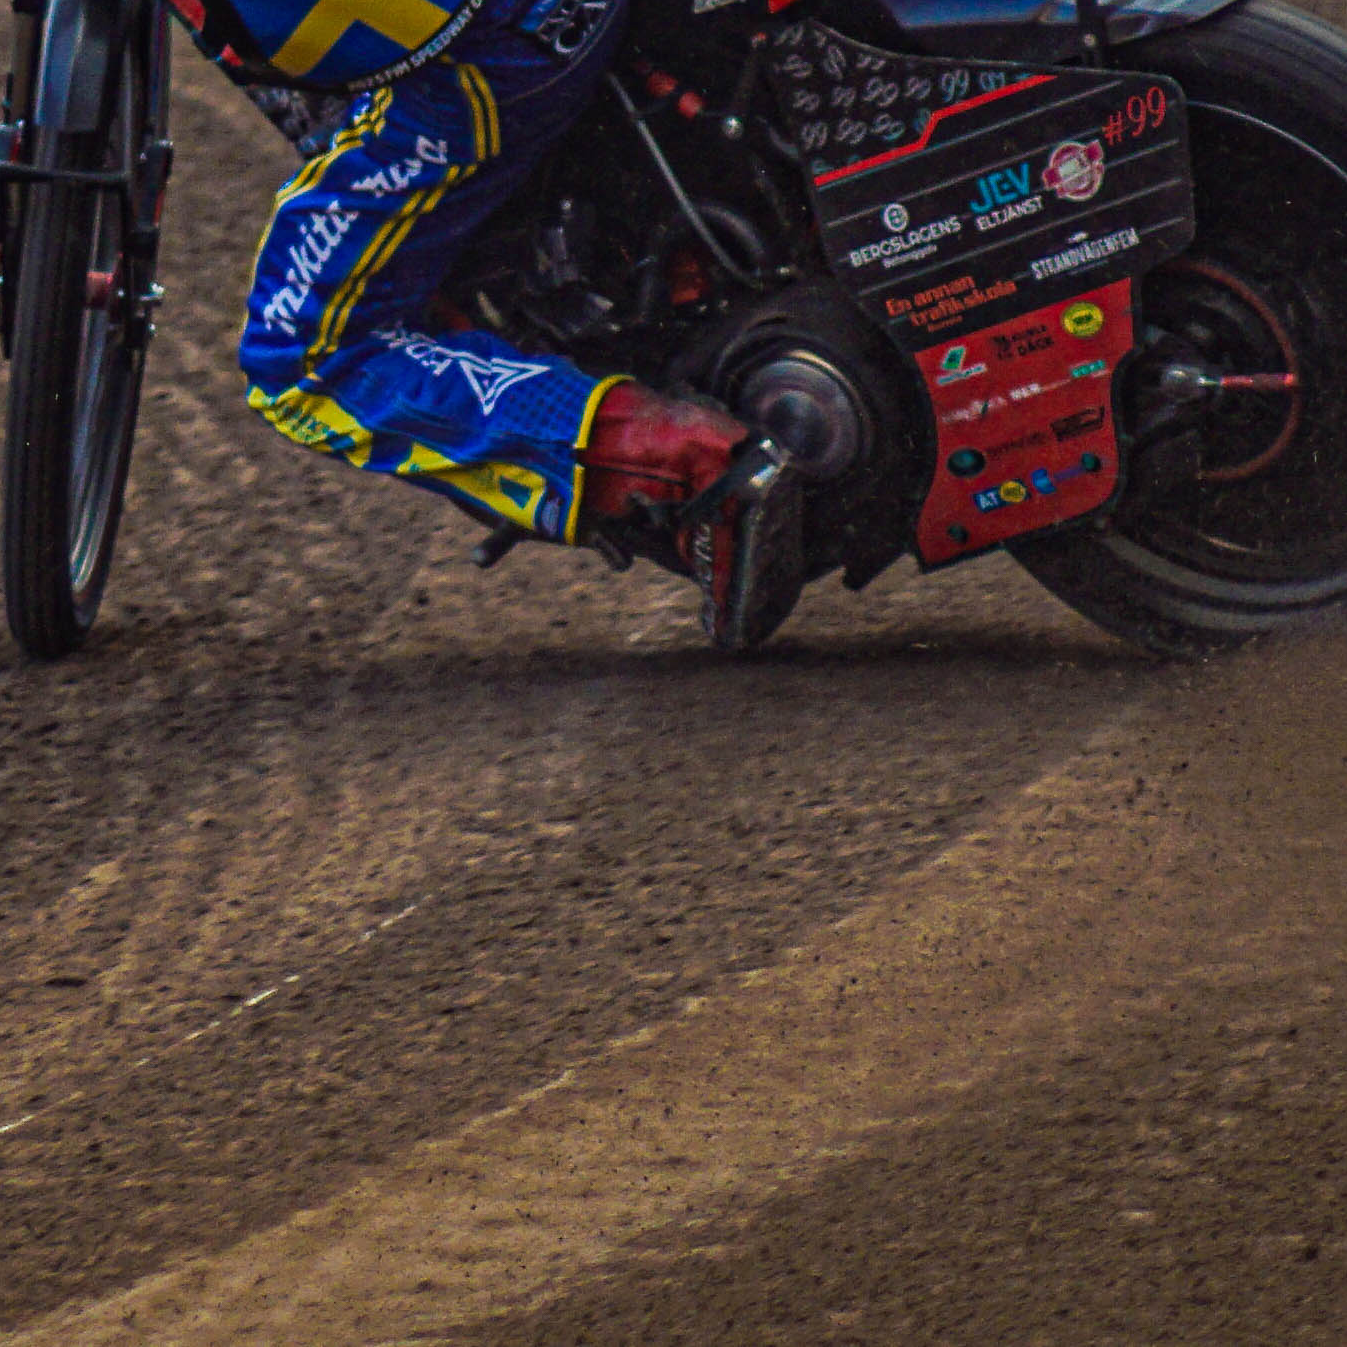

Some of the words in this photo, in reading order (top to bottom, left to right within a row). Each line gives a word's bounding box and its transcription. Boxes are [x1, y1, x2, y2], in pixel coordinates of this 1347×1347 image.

[1103, 87, 1166, 147] #99
[970, 163, 1030, 214] JEV
[265, 200, 358, 335] makita
